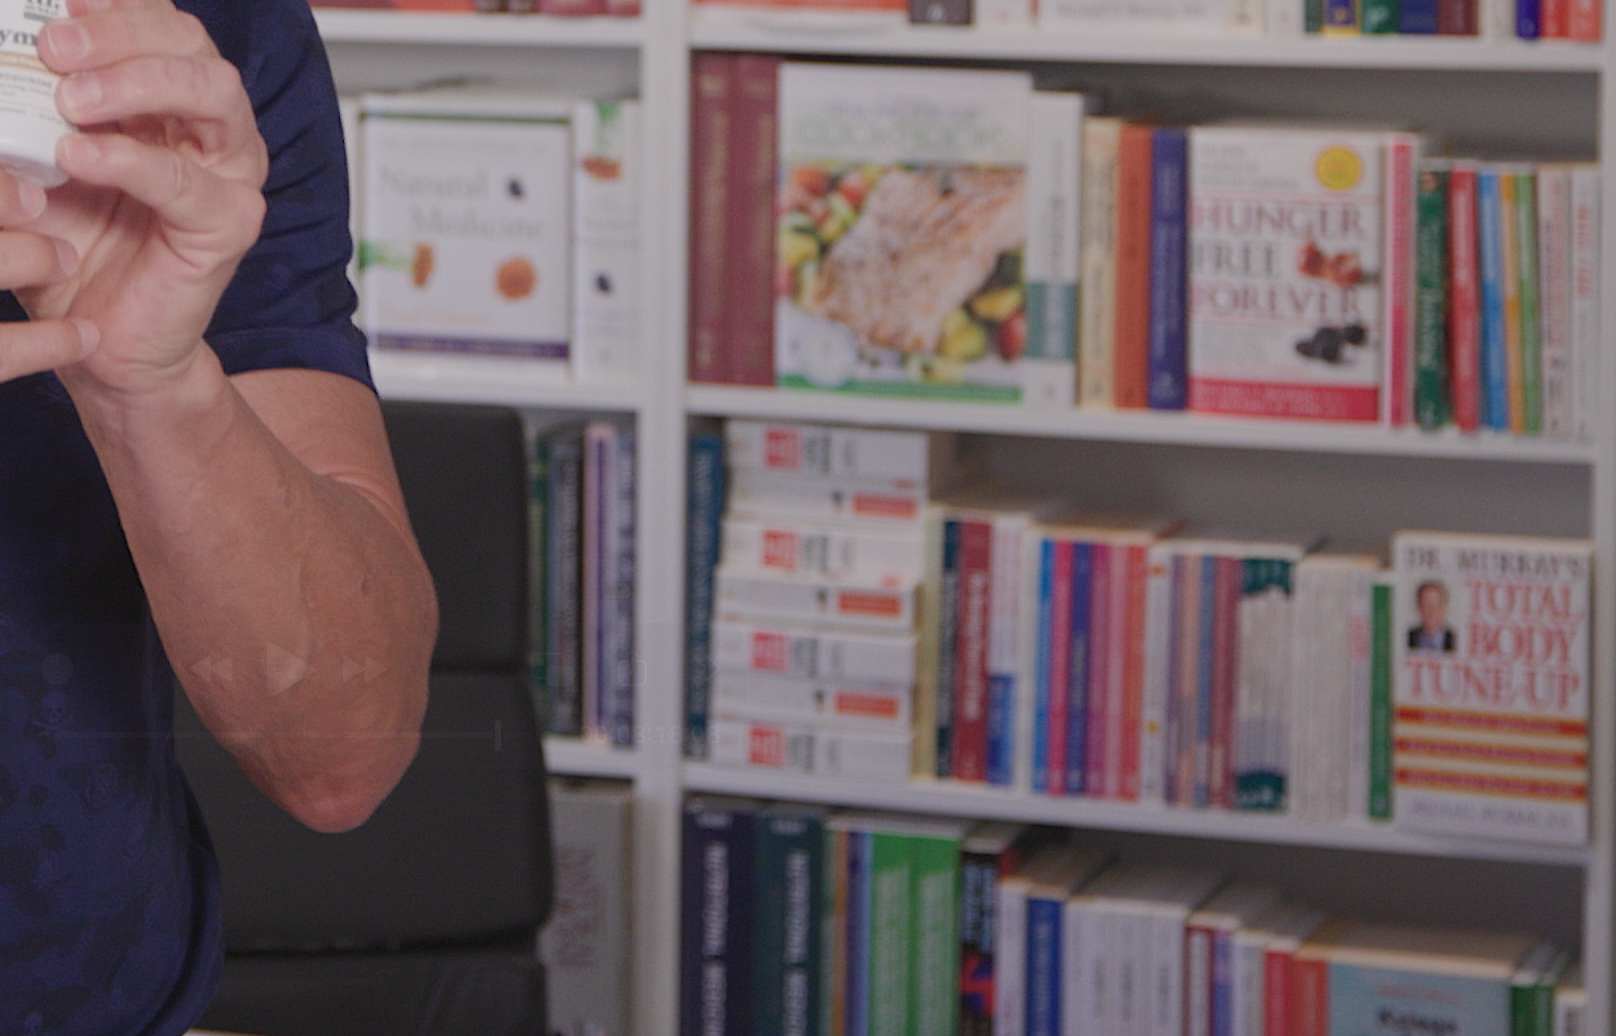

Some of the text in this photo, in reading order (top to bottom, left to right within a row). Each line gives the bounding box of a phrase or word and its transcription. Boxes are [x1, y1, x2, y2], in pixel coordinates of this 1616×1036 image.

[1195, 203, 1366, 240] HUNGER
[1195, 241, 1280, 279] FREE
[1195, 282, 1361, 318] FOREVER
[1466, 577, 1584, 624] TOTAL
[1467, 620, 1579, 664] BODY
